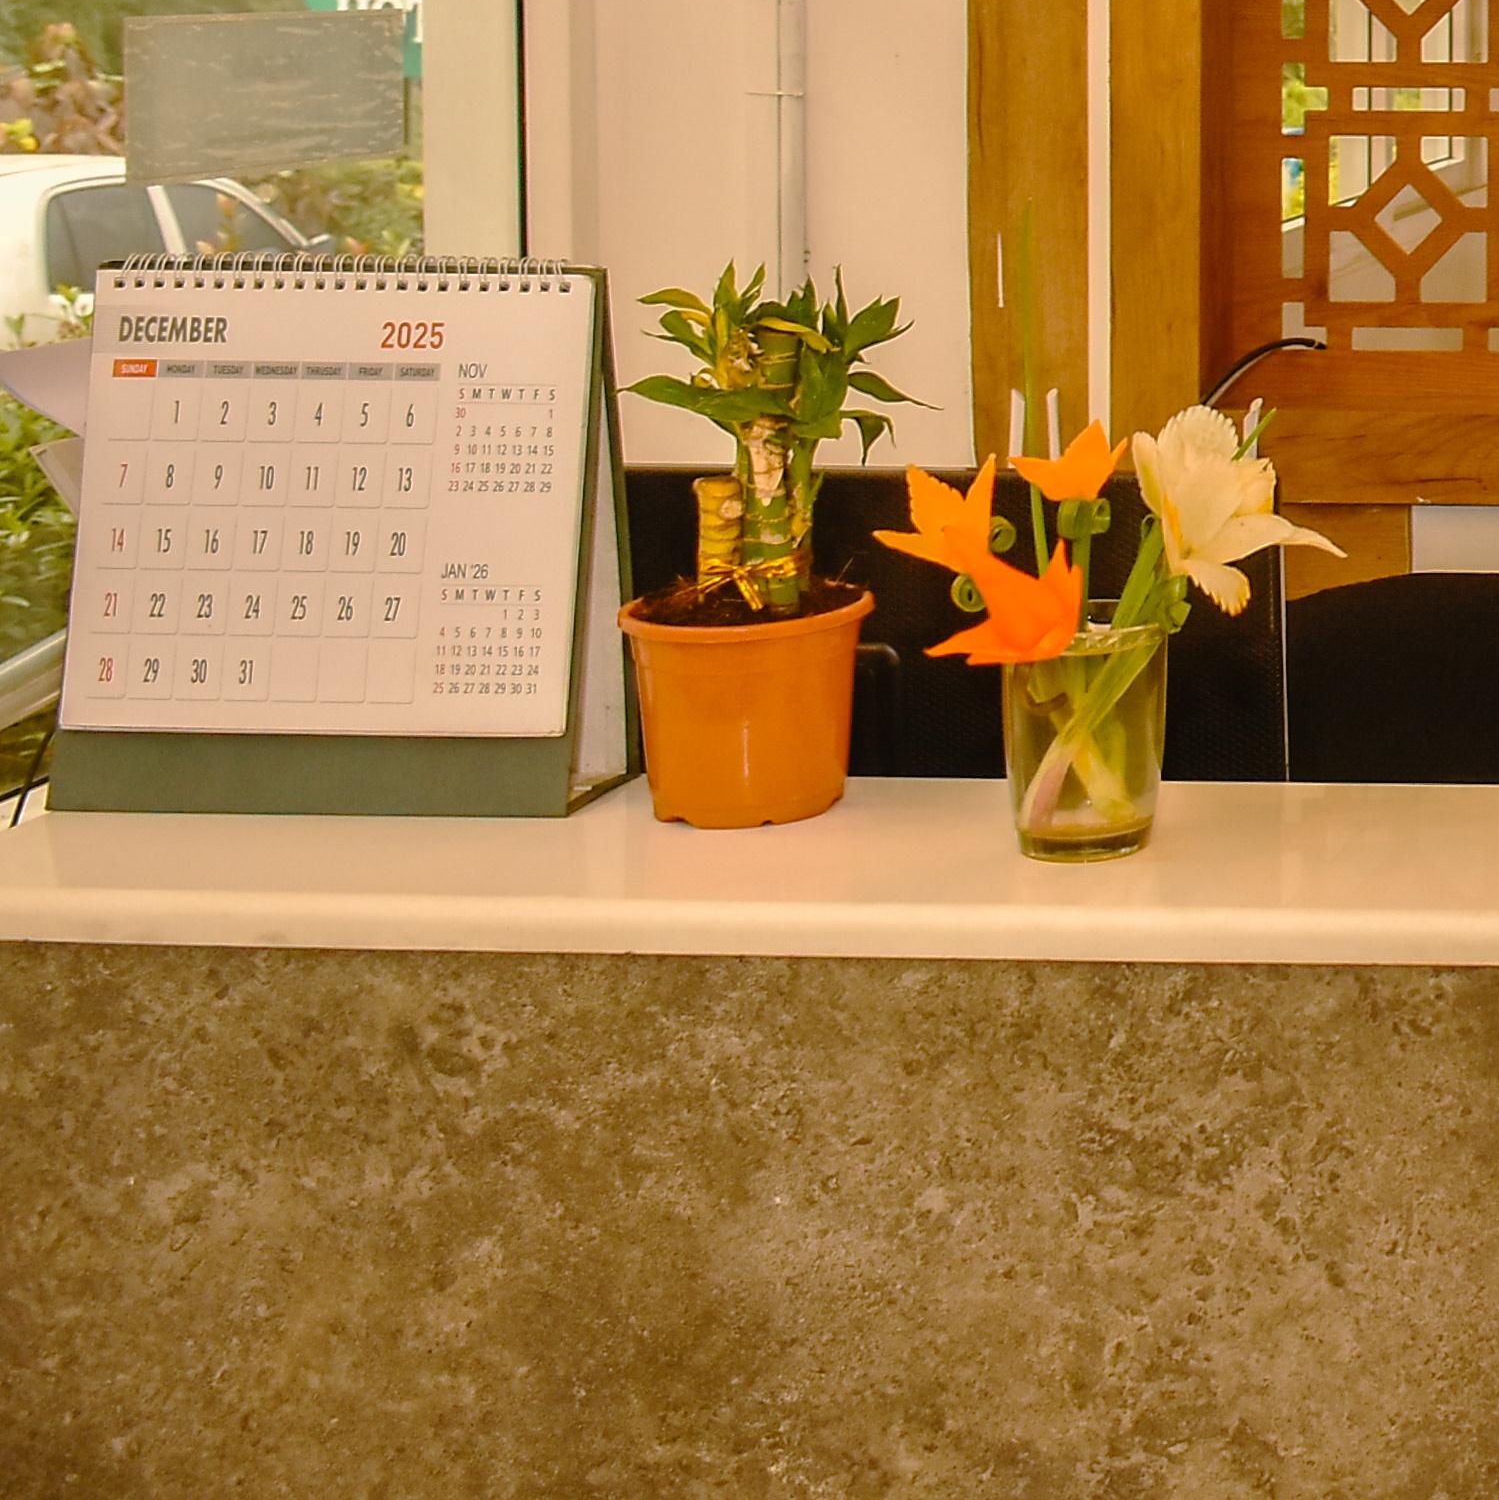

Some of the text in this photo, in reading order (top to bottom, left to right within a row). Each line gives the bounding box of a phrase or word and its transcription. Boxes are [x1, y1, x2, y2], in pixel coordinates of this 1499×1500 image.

[118, 316, 446, 350] DECEMBER 2025
[121, 364, 148, 374] SUNDAY
[166, 364, 195, 374] MONDAY
[213, 364, 244, 374] TUESDAY
[255, 364, 297, 375] WEDNESDAY
[358, 367, 383, 377] FRIDAY
[400, 367, 435, 378] SATURDAY
[458, 363, 488, 379] NOV
[459, 387, 556, 401] S M T W T F S
[173, 399, 415, 428] 1 2 3 4 5 6
[455, 406, 554, 420] 30 1
[455, 425, 553, 438] 2 3 4 5 6 7 8
[454, 443, 554, 457] 9 10 11 12 13 14 15
[451, 461, 553, 475] 16 17 18 19 20 21 22
[118, 463, 413, 493] 7 8 9 10 11 12 13
[447, 480, 552, 493] 23 24 25 26 27 28 29
[111, 527, 407, 557] 14 15 16 17 18 19 20
[441, 563, 467, 579] JAN
[441, 588, 541, 602] S M T W T F S
[103, 592, 401, 622] 21 22 23 24 25 26 27
[503, 608, 540, 621] 1 2 3
[439, 626, 543, 640] 4 5 6 7 8 9 10
[97, 657, 254, 685] 28 29 30 31
